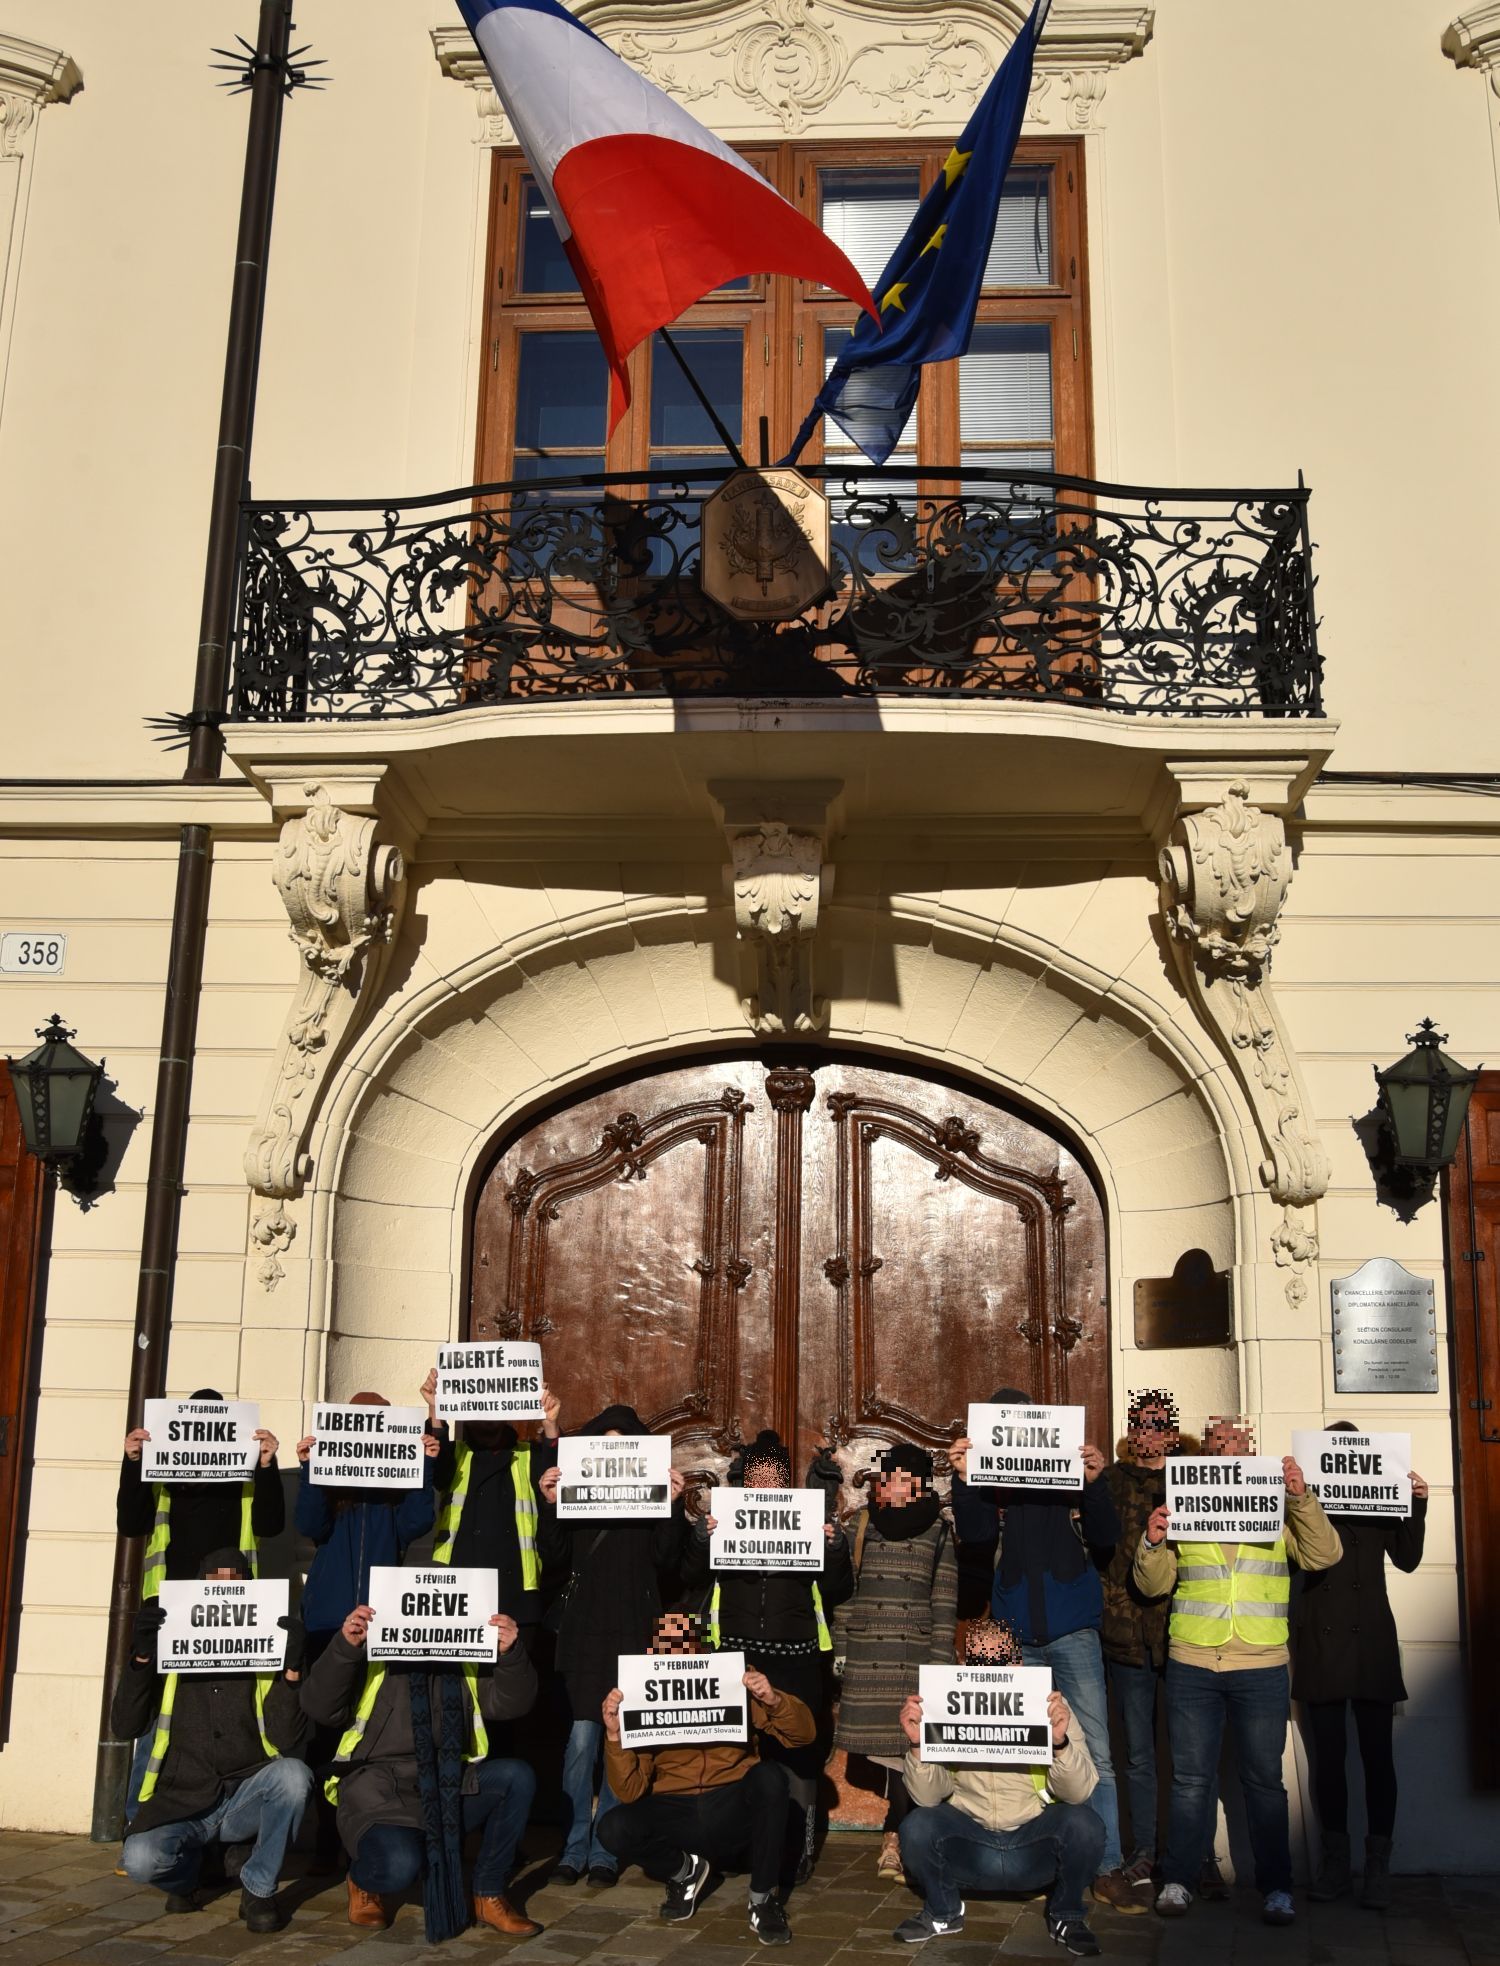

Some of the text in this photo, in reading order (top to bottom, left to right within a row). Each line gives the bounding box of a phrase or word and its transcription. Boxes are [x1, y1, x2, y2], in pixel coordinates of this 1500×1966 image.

[19, 941, 58, 965] 358
[439, 1347, 539, 1369] LIBERTÉ POUR LES
[442, 1377, 538, 1394] PRISONNIERS
[191, 1406, 228, 1414] FEBRUARY
[461, 1400, 499, 1411] RÉVOLTE
[317, 1411, 421, 1434] LIBERTÉ POUR LES
[1013, 1411, 1051, 1419] FEBRUARY
[169, 1421, 237, 1442] STRIKE
[992, 1426, 1060, 1448] STRIKE
[1332, 1436, 1370, 1446] 5 FÉVRIER
[156, 1452, 247, 1465] IN SOLIDARITY
[318, 1441, 416, 1460] PRISONNIERS
[581, 1457, 648, 1478] STRIKE
[981, 1456, 1071, 1472] IN SOLIDARITY
[1320, 1450, 1382, 1475] GRÈVE
[314, 1467, 323, 1475] DE
[335, 1464, 375, 1477] RÉVOLTE
[378, 1467, 419, 1478] SOCIALE!
[1171, 1462, 1282, 1485] LIBERTÉ POUR LES
[577, 1488, 652, 1499] IN SOLIDARITY
[756, 1494, 793, 1502] FEBRUARY
[1307, 1484, 1399, 1499] N SOLIDARITÉ
[1175, 1496, 1278, 1512] PRISONNIERS
[735, 1509, 801, 1530] STRIKE
[1183, 1523, 1192, 1531] LA
[1194, 1520, 1236, 1531] RÉVOLTE
[1239, 1520, 1280, 1531] SOCIALE!
[724, 1540, 812, 1554] IN SOLIDARITY
[416, 1574, 456, 1584] 5 FÉVRIER
[204, 1586, 245, 1595] 5 FÉVRIER
[401, 1589, 468, 1616] GRÈVE
[191, 1600, 257, 1627] GRÈVE
[382, 1626, 484, 1643] EN SOLIDARITÉ
[173, 1636, 274, 1654] EN SOLIDARITÉ
[249, 1659, 280, 1667] Slovaquie
[668, 1660, 709, 1670] FEBRUARY
[970, 1674, 1014, 1683] FEBRUARY
[645, 1678, 720, 1702] STRIKE
[947, 1691, 1024, 1716] STRIKE
[641, 1709, 725, 1725] IN SOLIDARITY
[627, 1731, 653, 1739] PRIAMA
[943, 1726, 1030, 1741] IN SOLIDARITY
